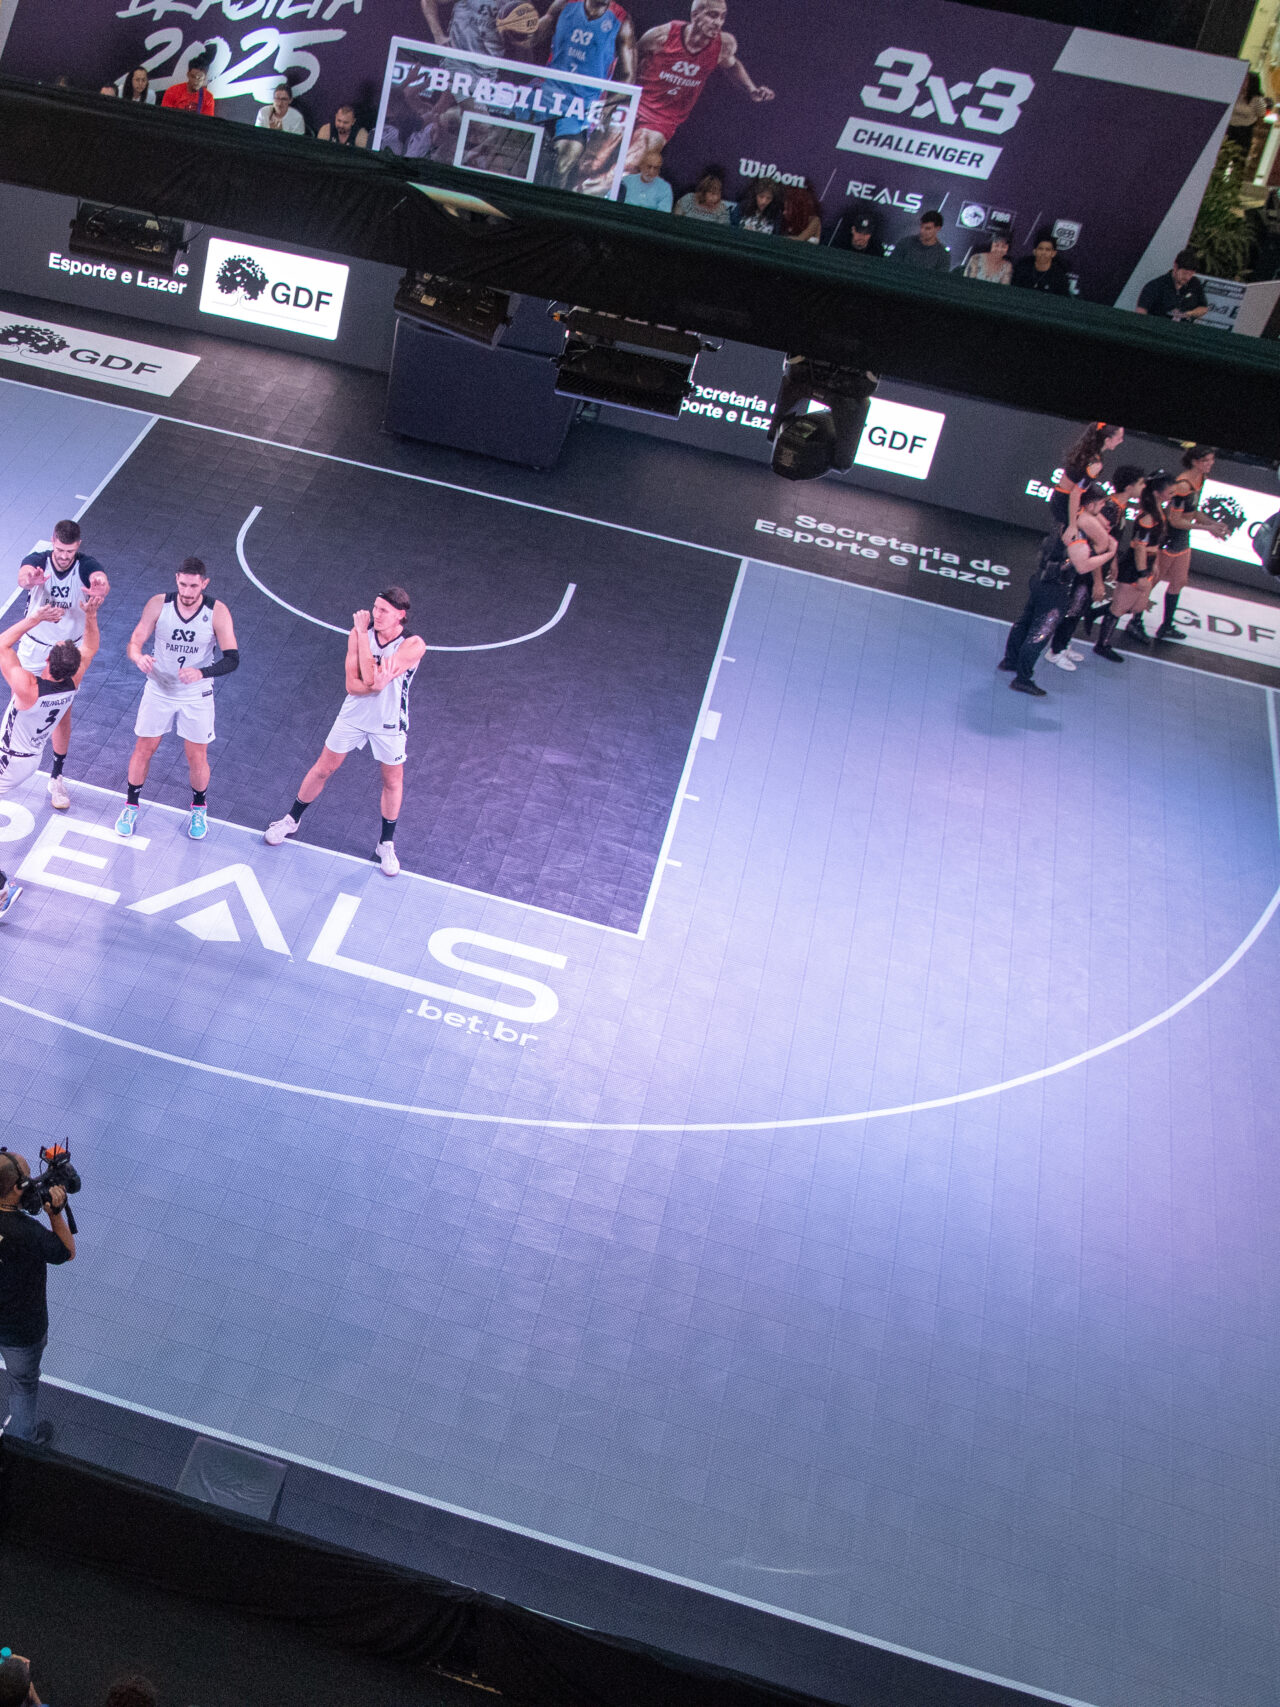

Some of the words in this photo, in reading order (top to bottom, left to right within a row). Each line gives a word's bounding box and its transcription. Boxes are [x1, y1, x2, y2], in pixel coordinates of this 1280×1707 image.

[114, 26, 348, 104] 2025
[860, 46, 1036, 135] 3x3
[852, 128, 984, 169] CHALLENGER
[738, 157, 807, 189] Wilson
[845, 180, 924, 211] REALS
[48, 252, 117, 281] Esporte
[120, 269, 133, 284] e
[136, 270, 188, 296] Lazer
[270, 281, 334, 313] GDF
[69, 348, 163, 376] GDF
[681, 398, 723, 420] porte
[725, 410, 738, 423] e
[740, 410, 772, 432] Laz
[694, 384, 768, 413] ecretaria
[867, 425, 928, 455] GDF
[753, 518, 880, 560] Esporte
[888, 552, 910, 567] e
[918, 558, 1012, 591] Lazer
[794, 514, 961, 566] Secretaria
[969, 558, 1011, 577] de
[1173, 607, 1277, 643] GDF
[165, 642, 200, 654] PARTIZAN
[177, 655, 186, 670] 9
[36, 708, 61, 735] 3
[405, 997, 539, 1050] .bet.br
